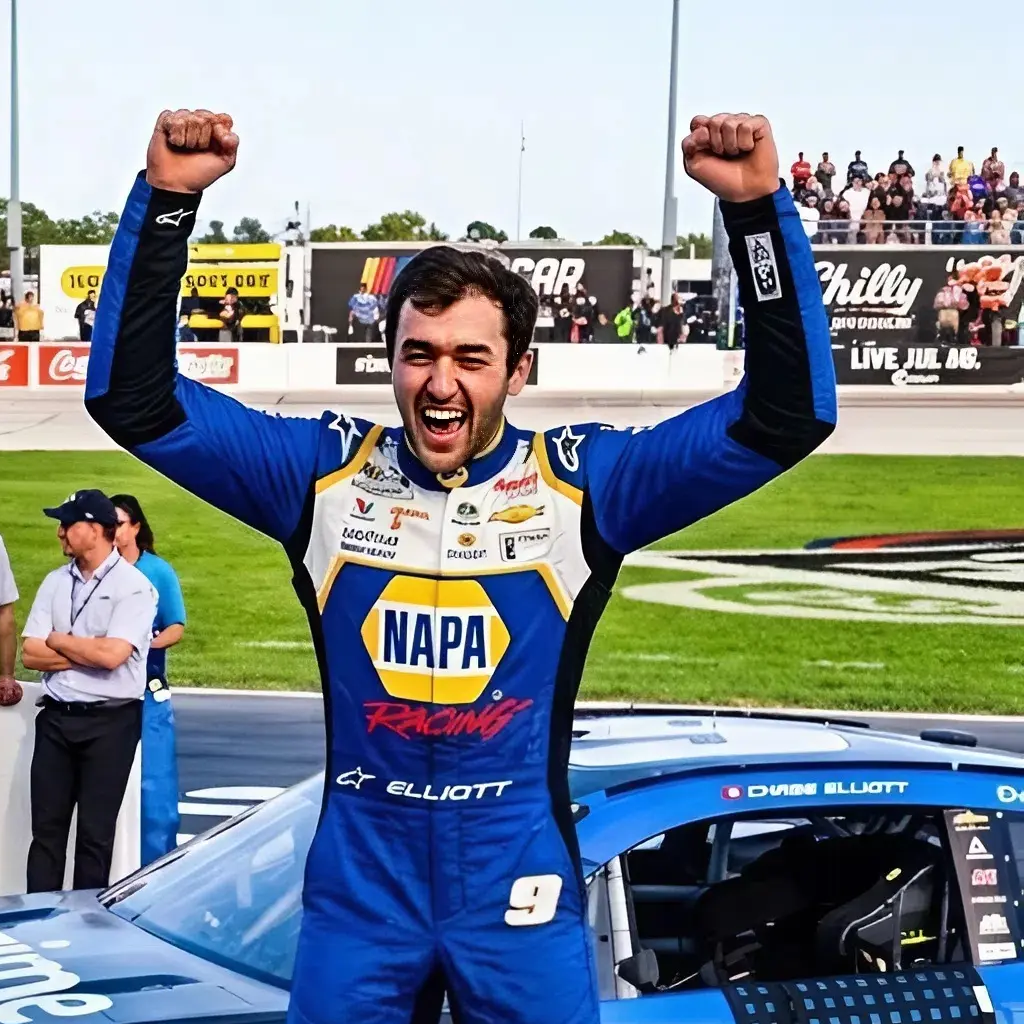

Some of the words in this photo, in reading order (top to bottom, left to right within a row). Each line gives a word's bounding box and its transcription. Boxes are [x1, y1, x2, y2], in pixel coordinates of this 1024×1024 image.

[383, 609, 487, 670] NAPA
[386, 779, 513, 801] ELLIOTT
[504, 873, 563, 927] 9
